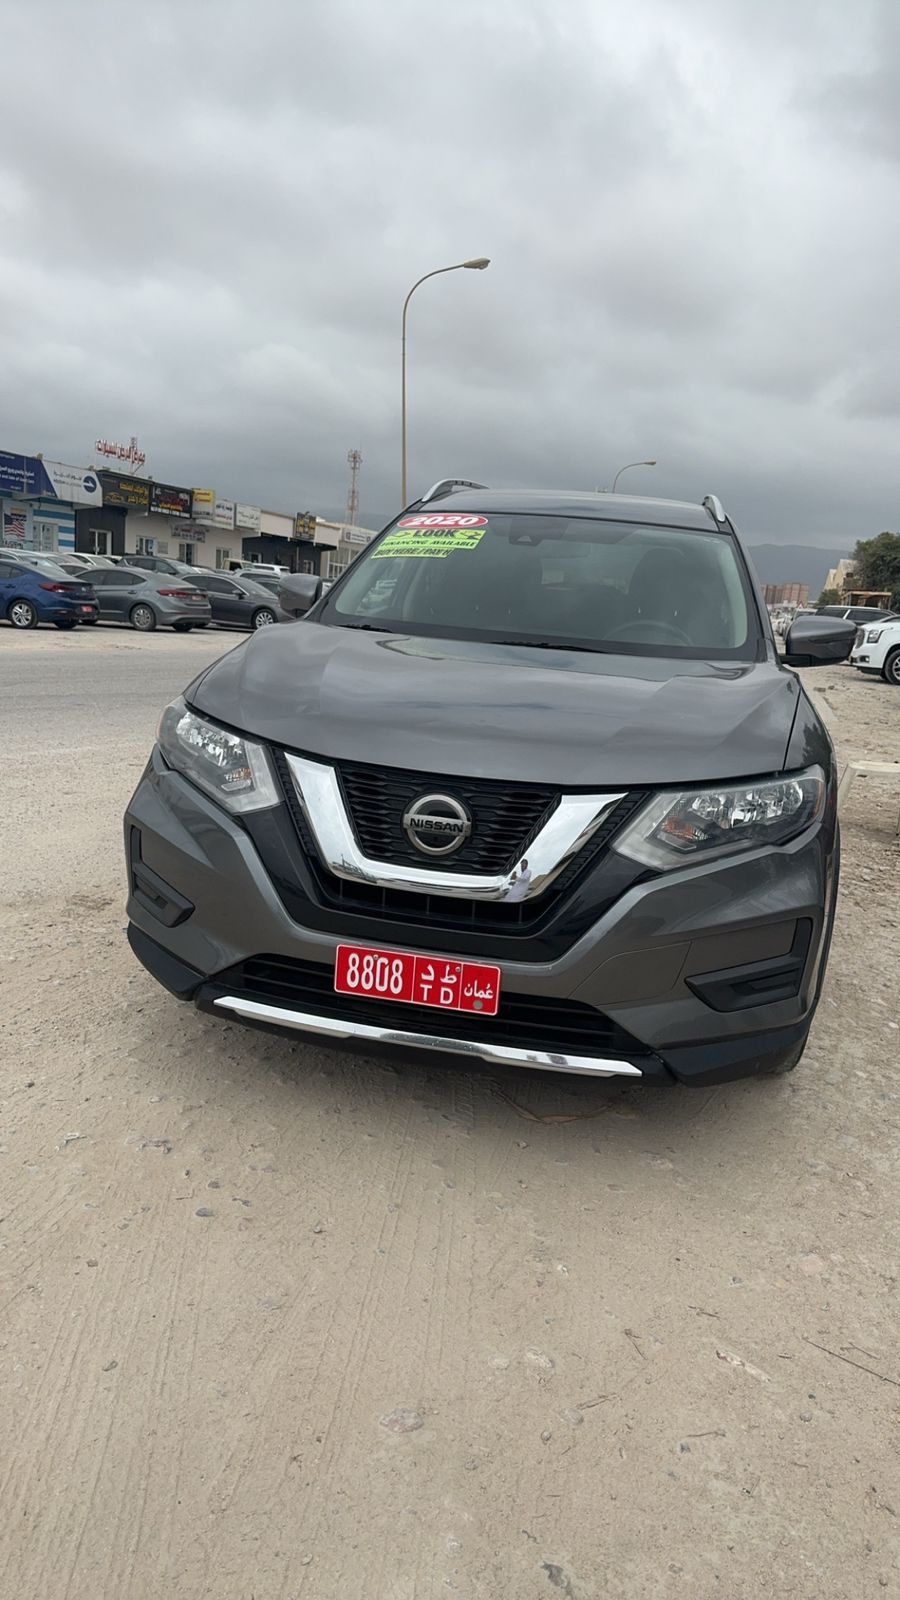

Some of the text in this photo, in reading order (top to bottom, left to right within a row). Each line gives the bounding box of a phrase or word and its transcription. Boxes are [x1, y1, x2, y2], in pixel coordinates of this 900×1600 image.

[410, 515, 478, 527] 2020
[412, 529, 460, 538] LOOK
[380, 539, 477, 547] FINANCING AVAILABLE
[410, 818, 464, 833] NISSAN
[346, 952, 404, 995] 8808
